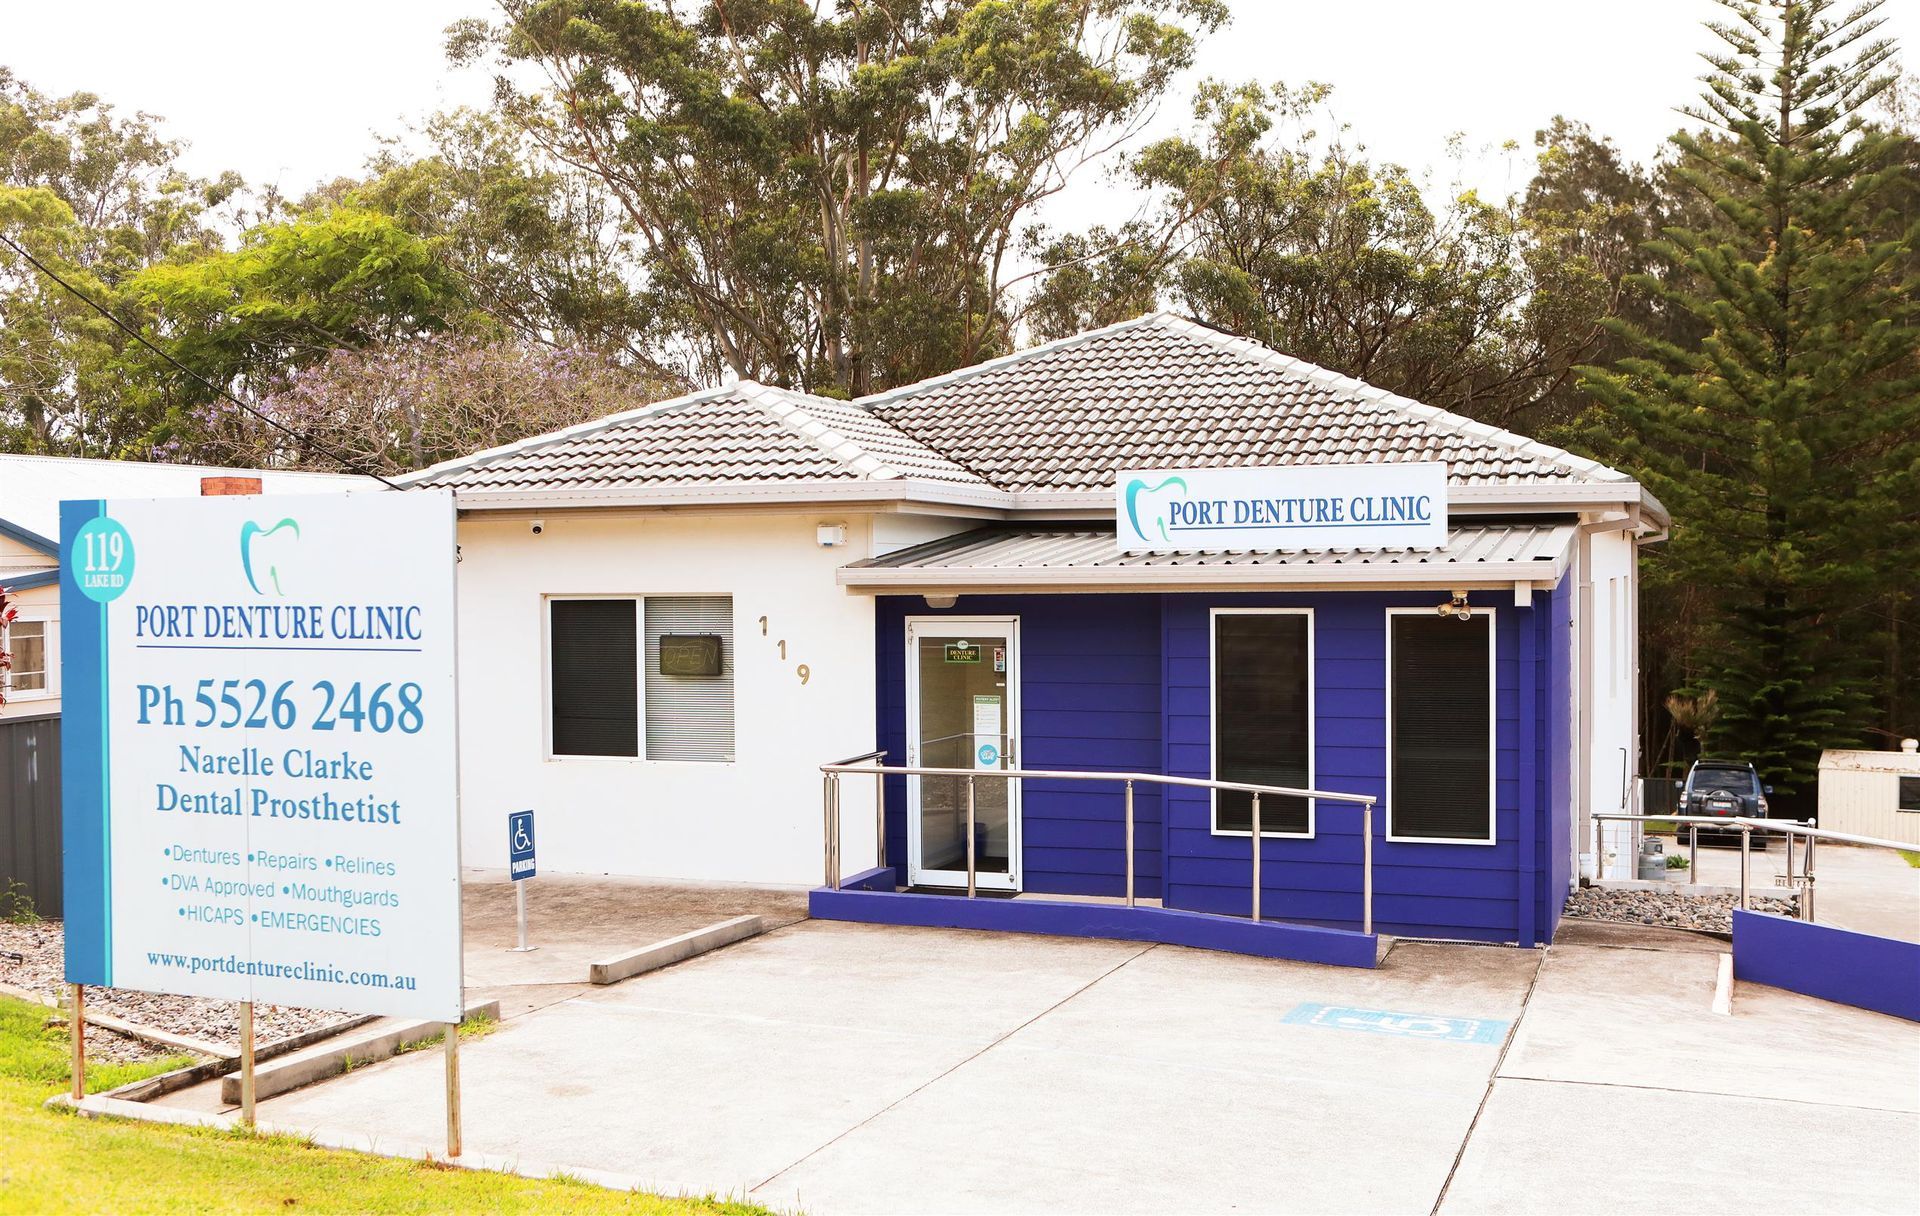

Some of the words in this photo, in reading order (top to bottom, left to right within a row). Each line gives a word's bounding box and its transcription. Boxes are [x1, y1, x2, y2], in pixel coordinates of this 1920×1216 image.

[1170, 501, 1227, 525] PORT
[1234, 498, 1343, 523] DENTURE
[1350, 496, 1430, 521] CLINIC
[84, 531, 124, 572] 119
[84, 574, 109, 588] LAKE
[110, 574, 124, 588] RD
[136, 605, 197, 637] PORT
[204, 606, 323, 639] DENTURE
[331, 606, 421, 640] CLINIC
[664, 647, 717, 665] OPEN
[137, 685, 185, 725] Ph
[195, 679, 296, 730] 5526
[312, 680, 423, 734] 2468
[180, 745, 273, 776] Narelle
[283, 749, 372, 780] Clarke
[157, 784, 242, 815] Dental
[251, 789, 400, 824] Prosthetist
[174, 845, 240, 865] Dentures
[258, 851, 317, 870] Repairs
[336, 855, 395, 875] Relines
[512, 858, 535, 874] PARKING
[173, 874, 198, 890] DVA
[206, 877, 274, 897] Approved
[292, 883, 398, 908] Mouthguards
[188, 906, 243, 925] HICAPS
[262, 911, 380, 936] EMERGENCIES
[148, 953, 415, 990] www.portdentureclinic.com.au
